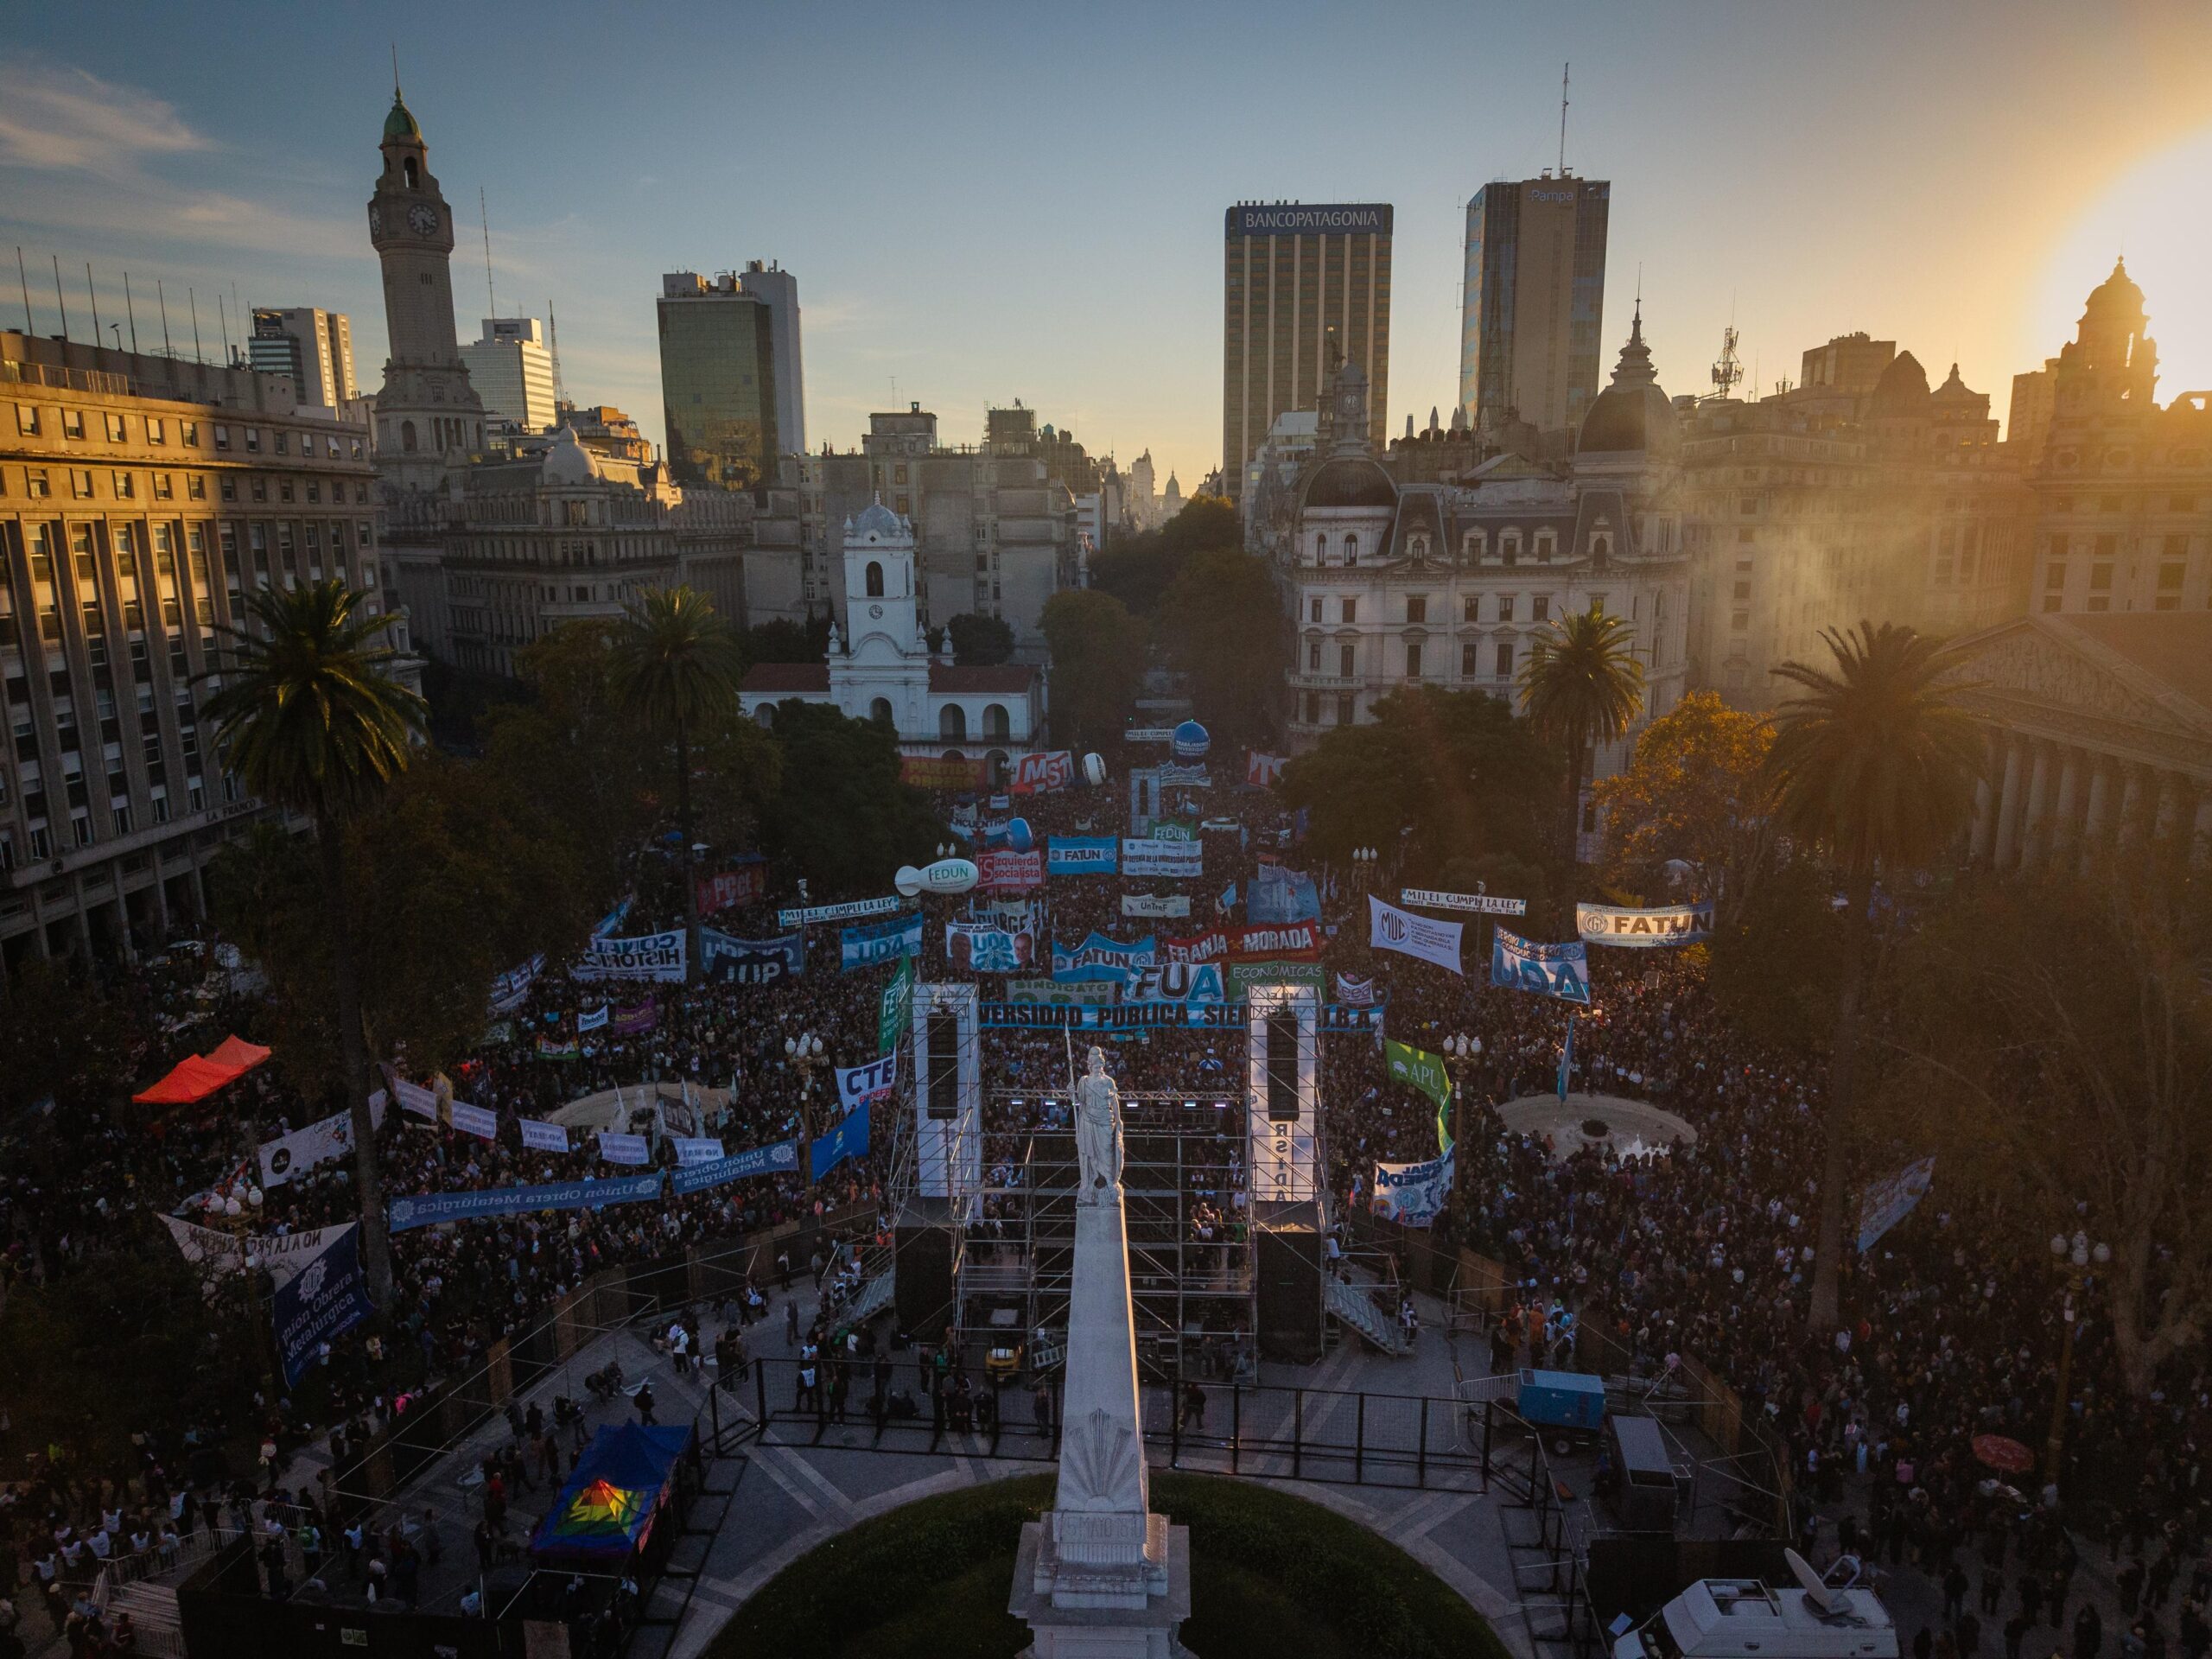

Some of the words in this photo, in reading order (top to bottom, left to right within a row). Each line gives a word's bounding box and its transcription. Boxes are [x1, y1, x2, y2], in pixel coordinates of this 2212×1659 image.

[1530, 189, 1574, 204] Pampa
[1245, 211, 1378, 228] BANCOPATAGONIA
[1154, 826, 1190, 841] FEDUN
[995, 855, 1038, 867] izquierda
[1065, 849, 1101, 861] FATUN
[929, 868, 969, 881] FEDUN
[995, 866, 1040, 879] socialista
[824, 903, 861, 915] CUMPLI
[864, 901, 874, 911] LA
[878, 898, 893, 908] LEY
[1141, 902, 1167, 912] UnTreF
[1487, 899, 1498, 907] LA
[1501, 899, 1518, 909] LEY
[1382, 912, 1405, 940] MUC
[1614, 912, 1710, 934] FATUN
[858, 935, 905, 963] UDA
[973, 933, 1013, 951] UDA
[1168, 934, 1228, 963] FRANJA
[1243, 927, 1313, 952] MORADA
[1072, 949, 1129, 969] FATUN
[1233, 962, 1322, 978] ECONÓMICAS
[1493, 945, 1589, 1002] UDA
[1014, 981, 1109, 992] SINDICATO
[1135, 963, 1223, 1001] FUA
[1410, 1063, 1440, 1090] APU
[313, 1272, 353, 1313] Obrera
[287, 1293, 355, 1362] Metalúrgica
